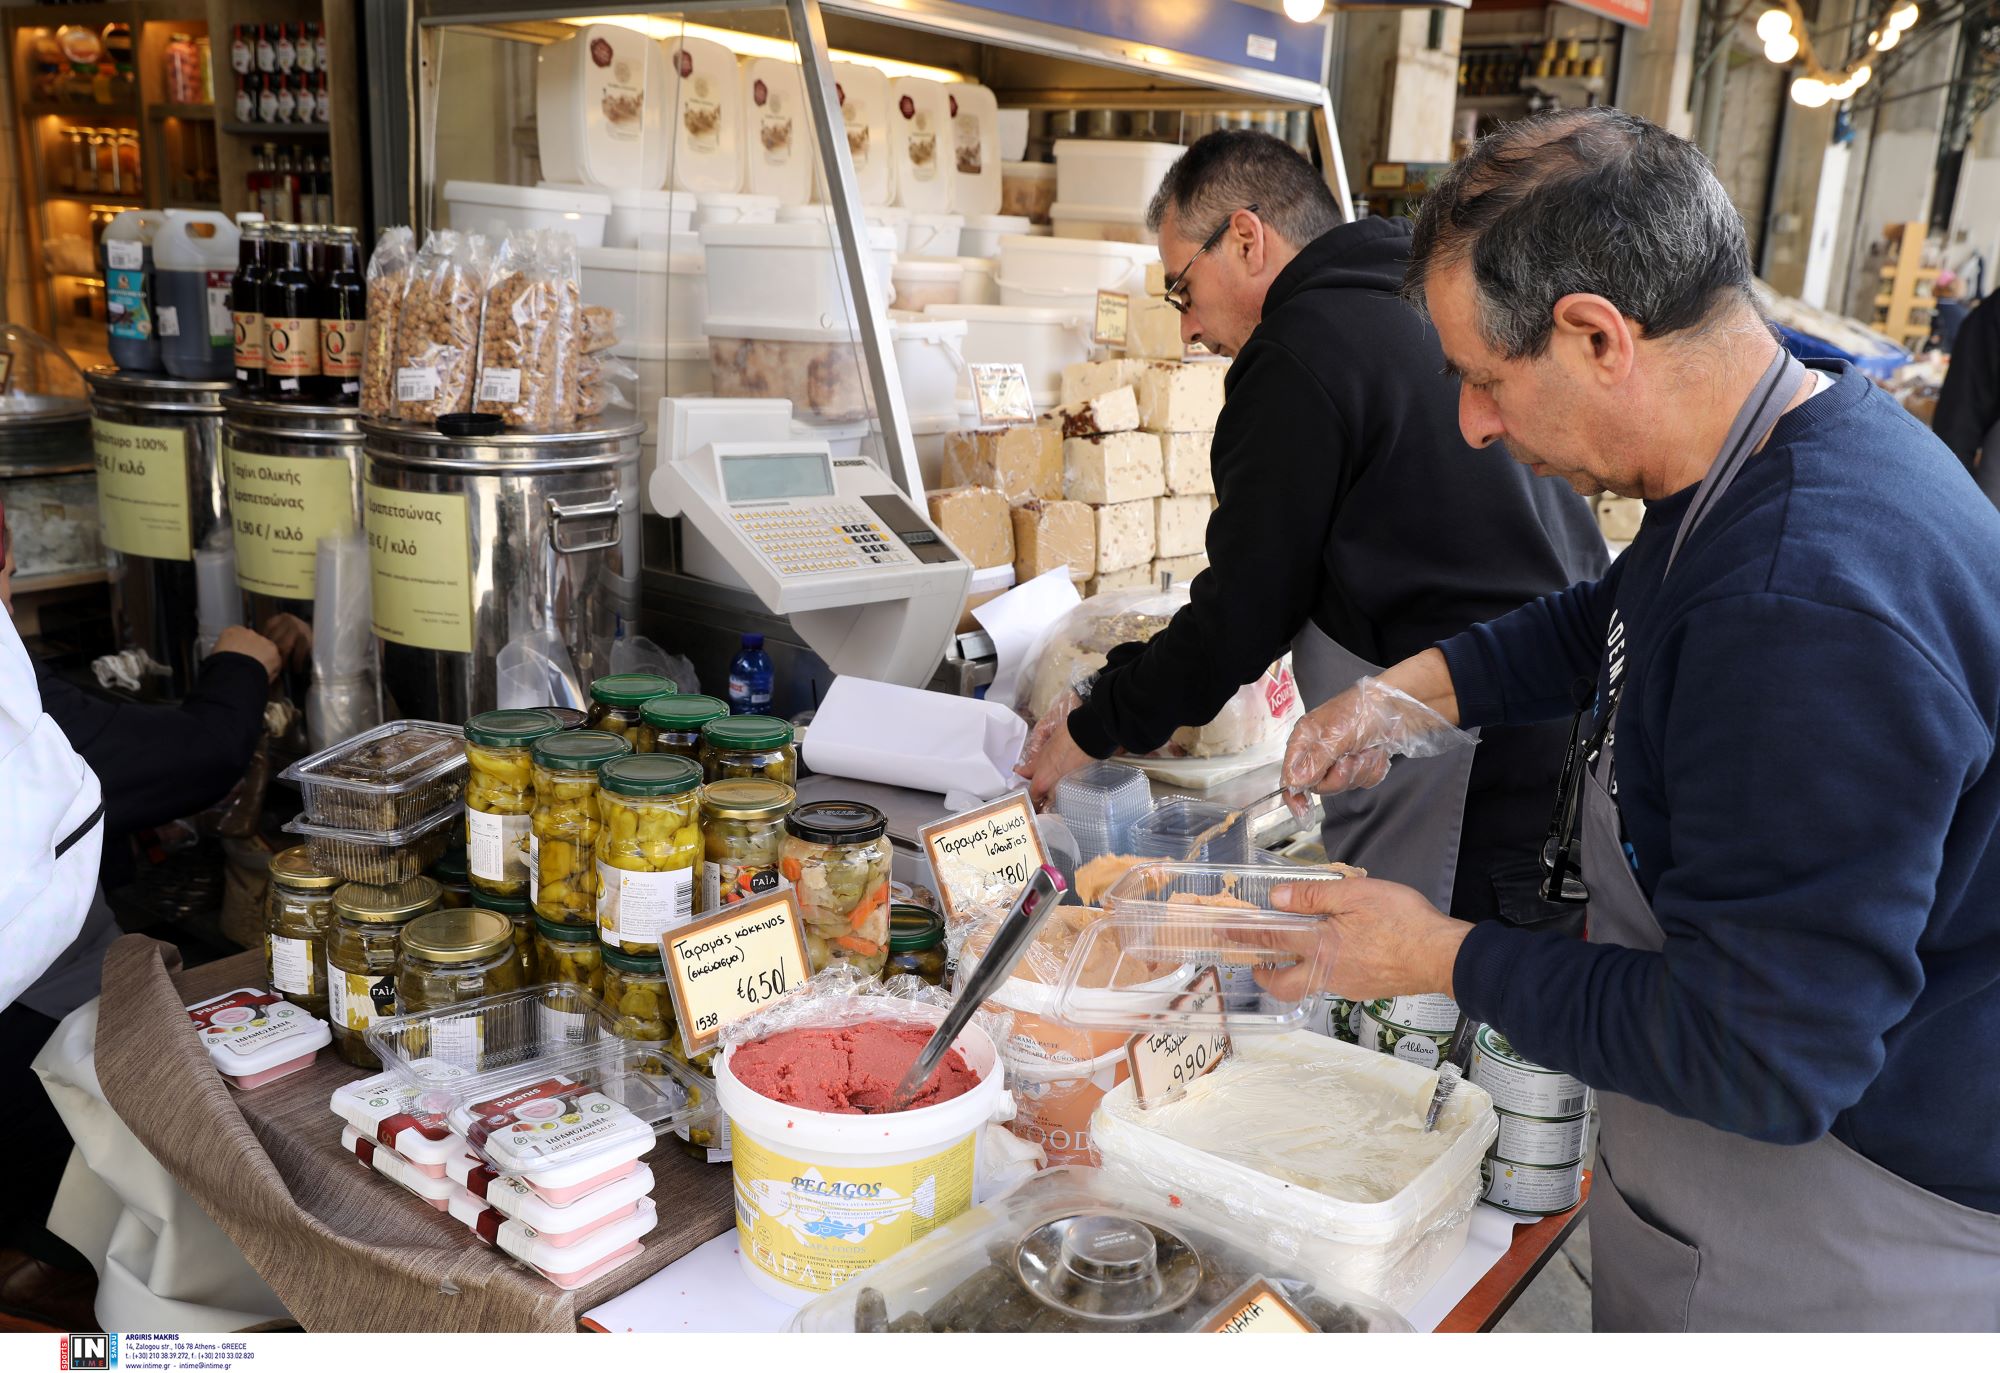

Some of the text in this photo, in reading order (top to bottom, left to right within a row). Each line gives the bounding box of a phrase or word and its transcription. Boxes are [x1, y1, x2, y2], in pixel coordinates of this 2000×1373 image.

[135, 437, 169, 452] 100%
[258, 467, 302, 486] Ολικής
[274, 526, 304, 541] κιλό
[391, 539, 417, 556] κιλό
[194, 999, 236, 1016] Pitenis
[696, 1012, 719, 1031] 1538
[1400, 1041, 1434, 1055] Aldoro
[496, 1088, 541, 1108] Pitenis
[791, 1176, 882, 1200] PELAGOS
